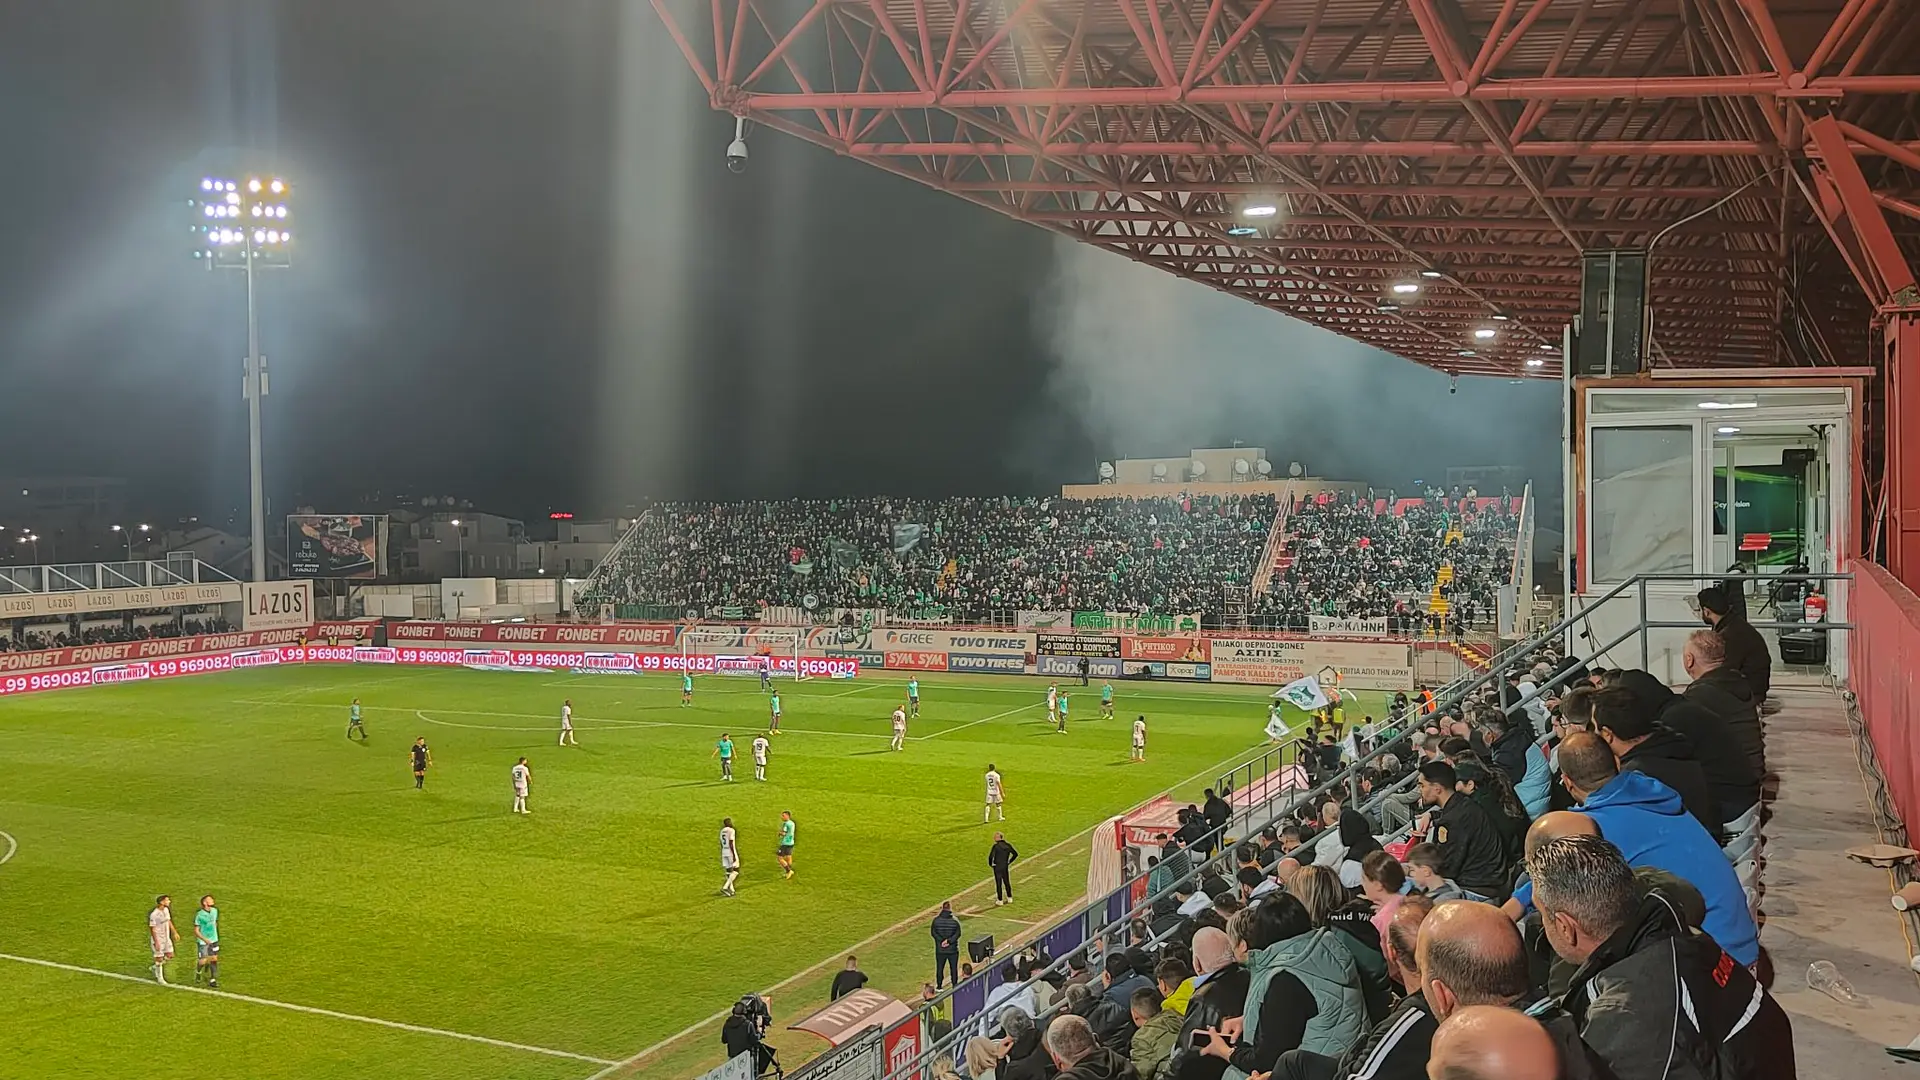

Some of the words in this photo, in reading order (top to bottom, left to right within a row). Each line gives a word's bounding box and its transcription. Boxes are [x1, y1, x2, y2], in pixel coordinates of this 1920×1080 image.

[249, 587, 302, 615] LAZOS
[260, 628, 308, 646] FONBET
[318, 625, 369, 636] FONBET
[396, 626, 435, 637] FONBET
[444, 627, 483, 638] FONBET
[498, 627, 547, 640] FONBET
[556, 628, 608, 641] FONBET
[617, 629, 670, 642] FONBET
[201, 633, 254, 650] FONBET
[900, 633, 934, 644] GREE
[950, 637, 985, 647] TOYO
[988, 638, 1026, 649] TIRES
[1245, 641, 1304, 649] ΘΕΡΜΟΣΙΦΩΝΕΣ
[71, 644, 132, 663] FONBET
[140, 639, 195, 656] FONBET
[287, 648, 304, 660] 99
[308, 648, 352, 660] 969082
[0, 651, 63, 670] FONBET
[403, 651, 417, 662] 99
[419, 651, 462, 663] 969082
[518, 654, 533, 665] 99
[536, 654, 583, 667] 969082
[643, 656, 660, 669] 99
[663, 656, 713, 670] 969082
[888, 653, 915, 665] SYM
[916, 653, 945, 667] SYM
[952, 657, 986, 667] TOYO
[987, 658, 1025, 669] TIRES
[159, 661, 177, 675] 99
[180, 656, 231, 673] 969082
[6, 677, 27, 692] 99
[30, 671, 91, 689] 969082
[989, 778, 994, 787] 2
[816, 989, 888, 1026] TITAN
